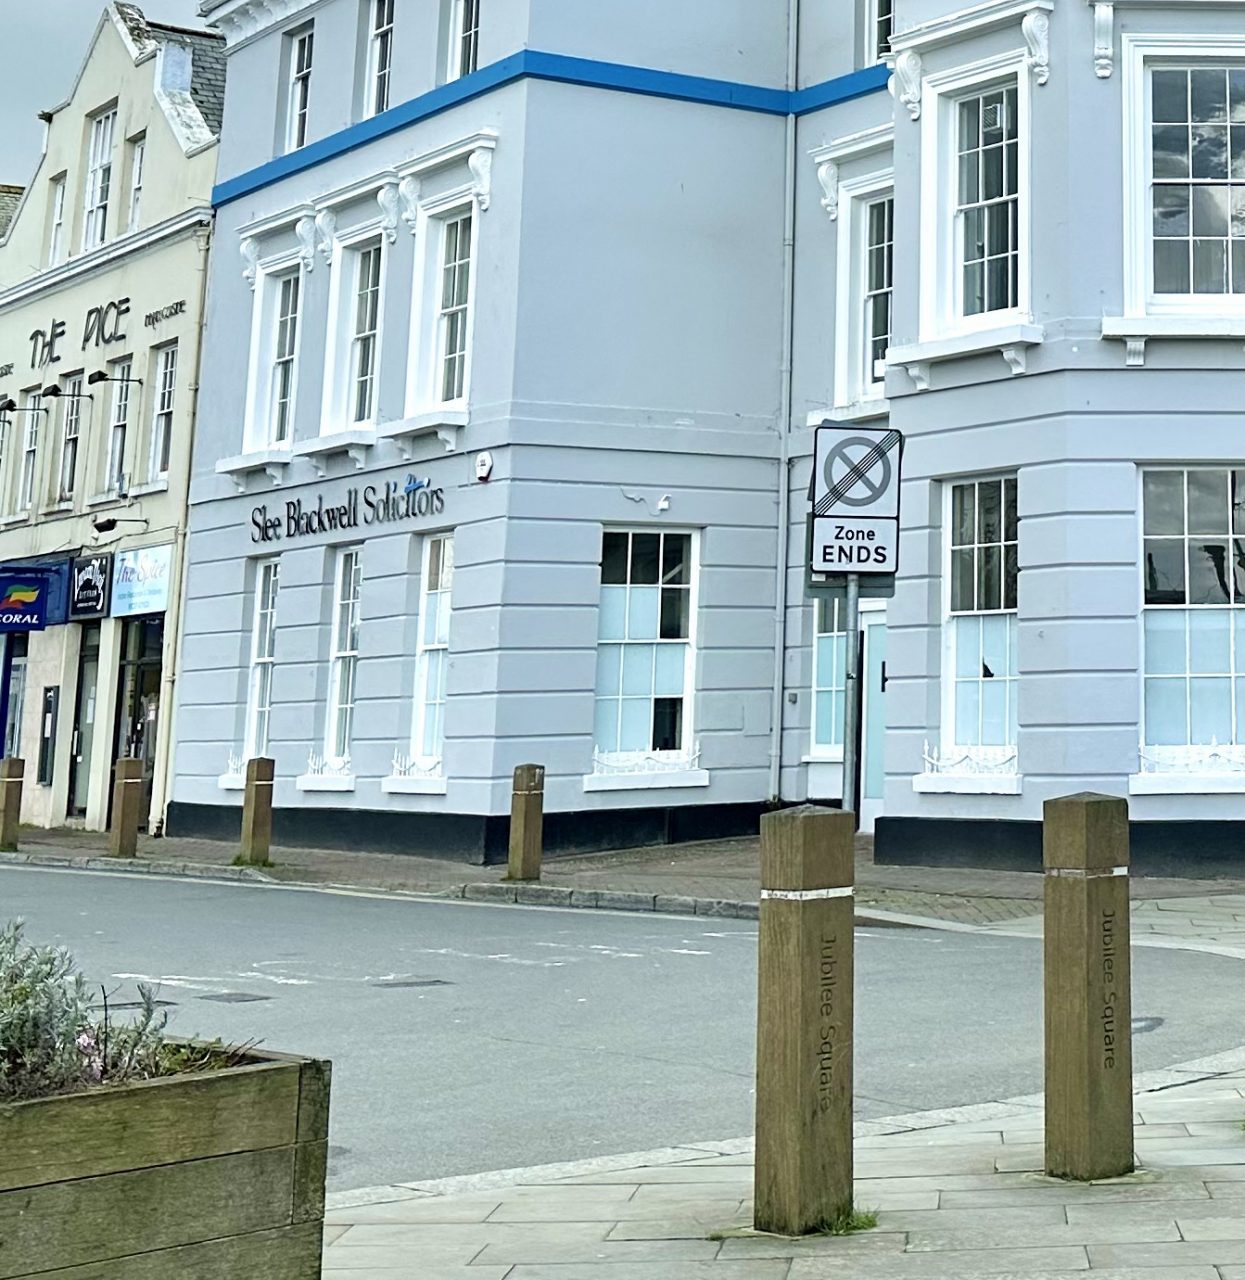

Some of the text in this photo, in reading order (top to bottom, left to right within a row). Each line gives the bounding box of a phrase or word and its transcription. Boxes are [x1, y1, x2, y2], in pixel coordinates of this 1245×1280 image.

[29, 318, 66, 369] THE
[251, 473, 444, 543] Slee Blackwell Solicitors
[834, 525, 876, 541] Zone
[822, 545, 887, 564] ENDS
[1101, 910, 1117, 1069] Jubilee Square
[816, 934, 838, 1114] Jubilee Square
